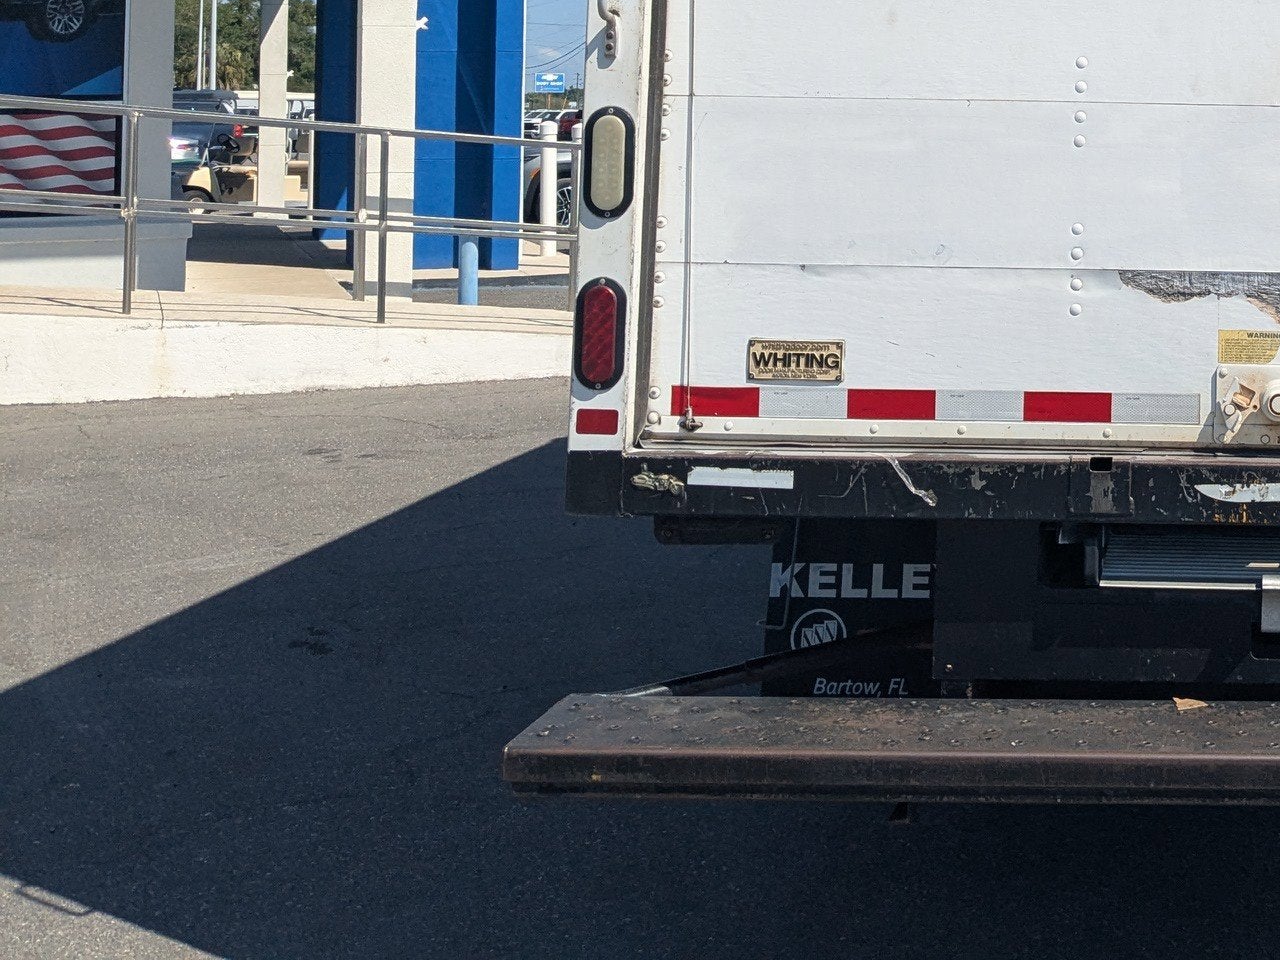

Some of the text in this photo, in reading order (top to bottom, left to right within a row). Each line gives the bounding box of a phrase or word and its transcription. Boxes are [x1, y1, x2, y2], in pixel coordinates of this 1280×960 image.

[752, 352, 840, 368] WHITING
[769, 562, 937, 599] KELLE
[813, 677, 909, 698] Bartow, FL
